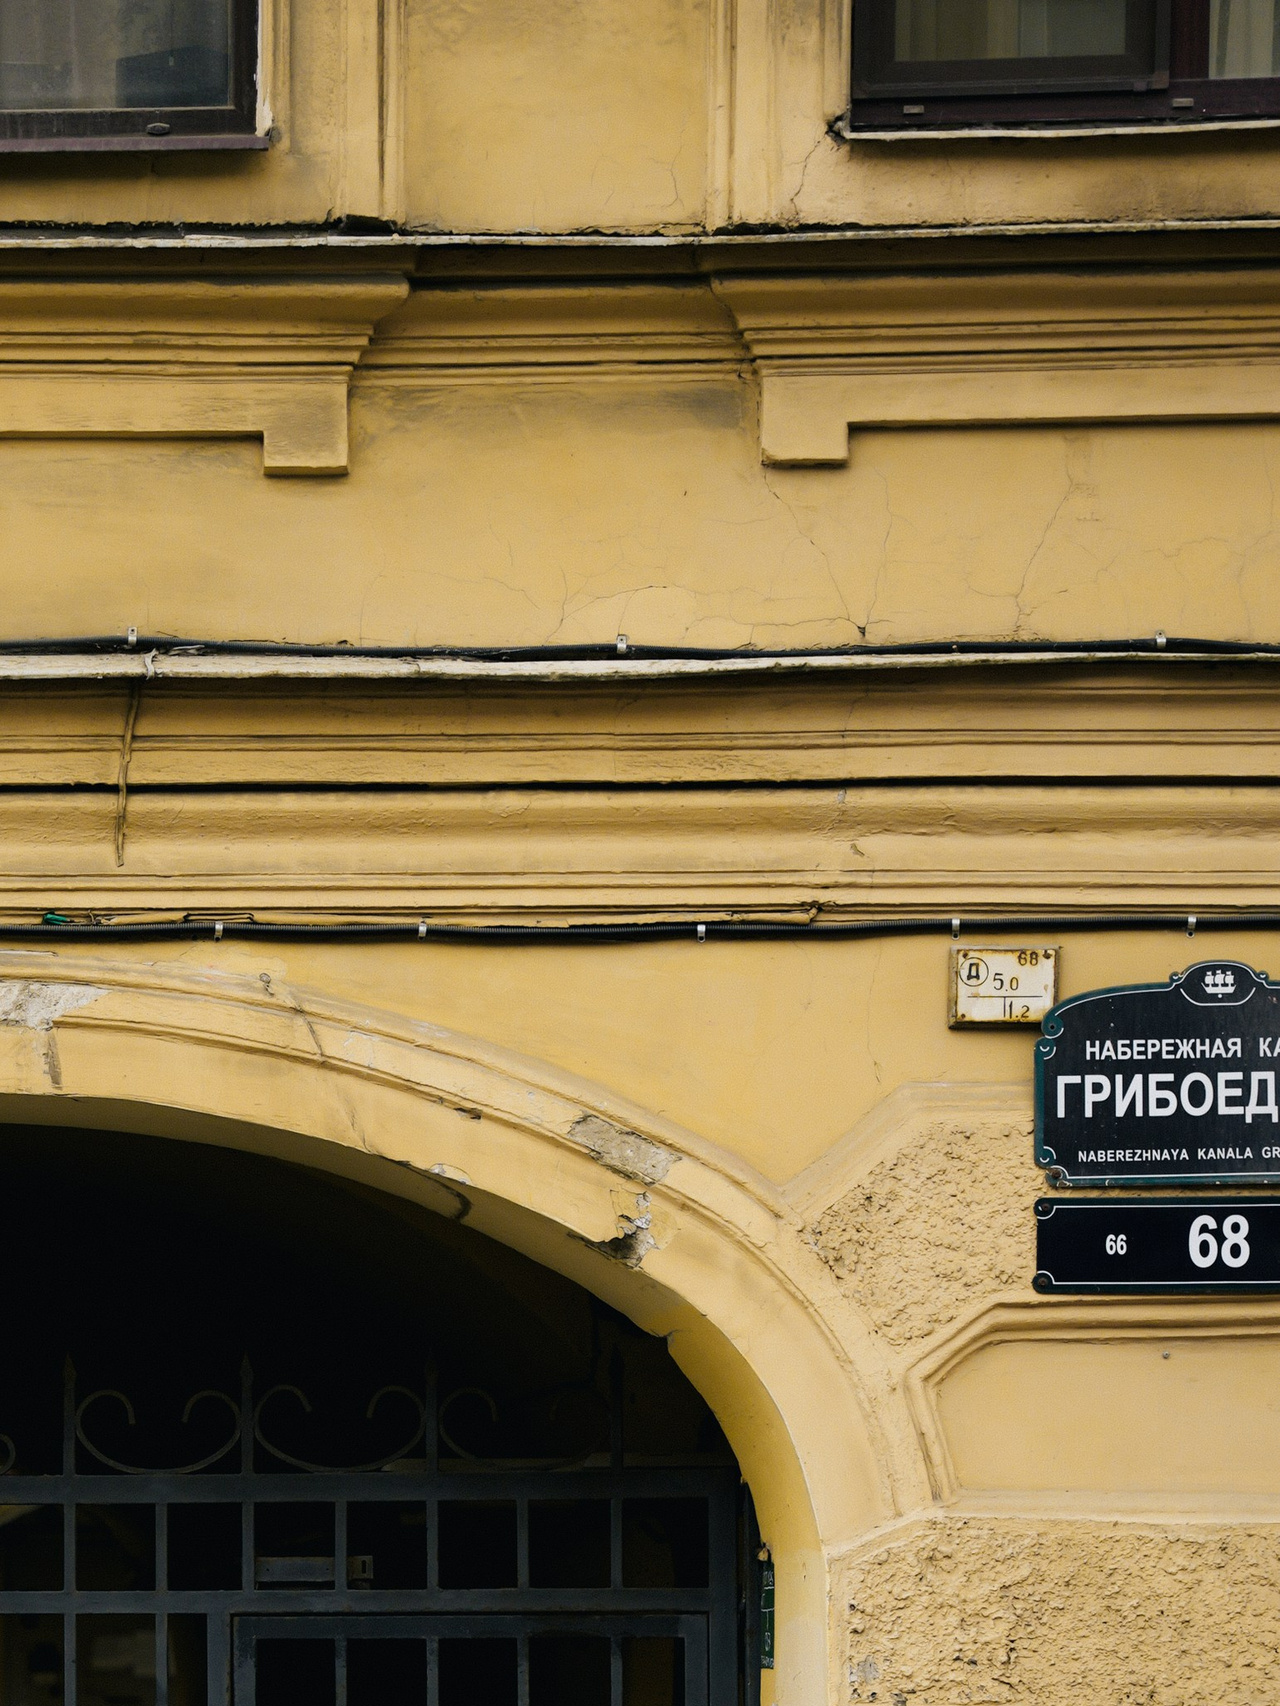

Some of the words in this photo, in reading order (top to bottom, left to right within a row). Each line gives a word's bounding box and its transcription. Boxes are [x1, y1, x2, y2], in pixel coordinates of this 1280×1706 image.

[1017, 951, 1039, 967] 68
[966, 962, 981, 981] Д
[993, 972, 1019, 992] 5.0
[1085, 1037, 1242, 1061] НАБЕРЕЖНАЯ
[1056, 1071, 1279, 1124] ГРИБОЕД
[1077, 1148, 1190, 1163] NABEREZHNAYA
[1196, 1146, 1254, 1161] KANALA
[1105, 1233, 1128, 1256] 66
[1187, 1213, 1251, 1269] 68
